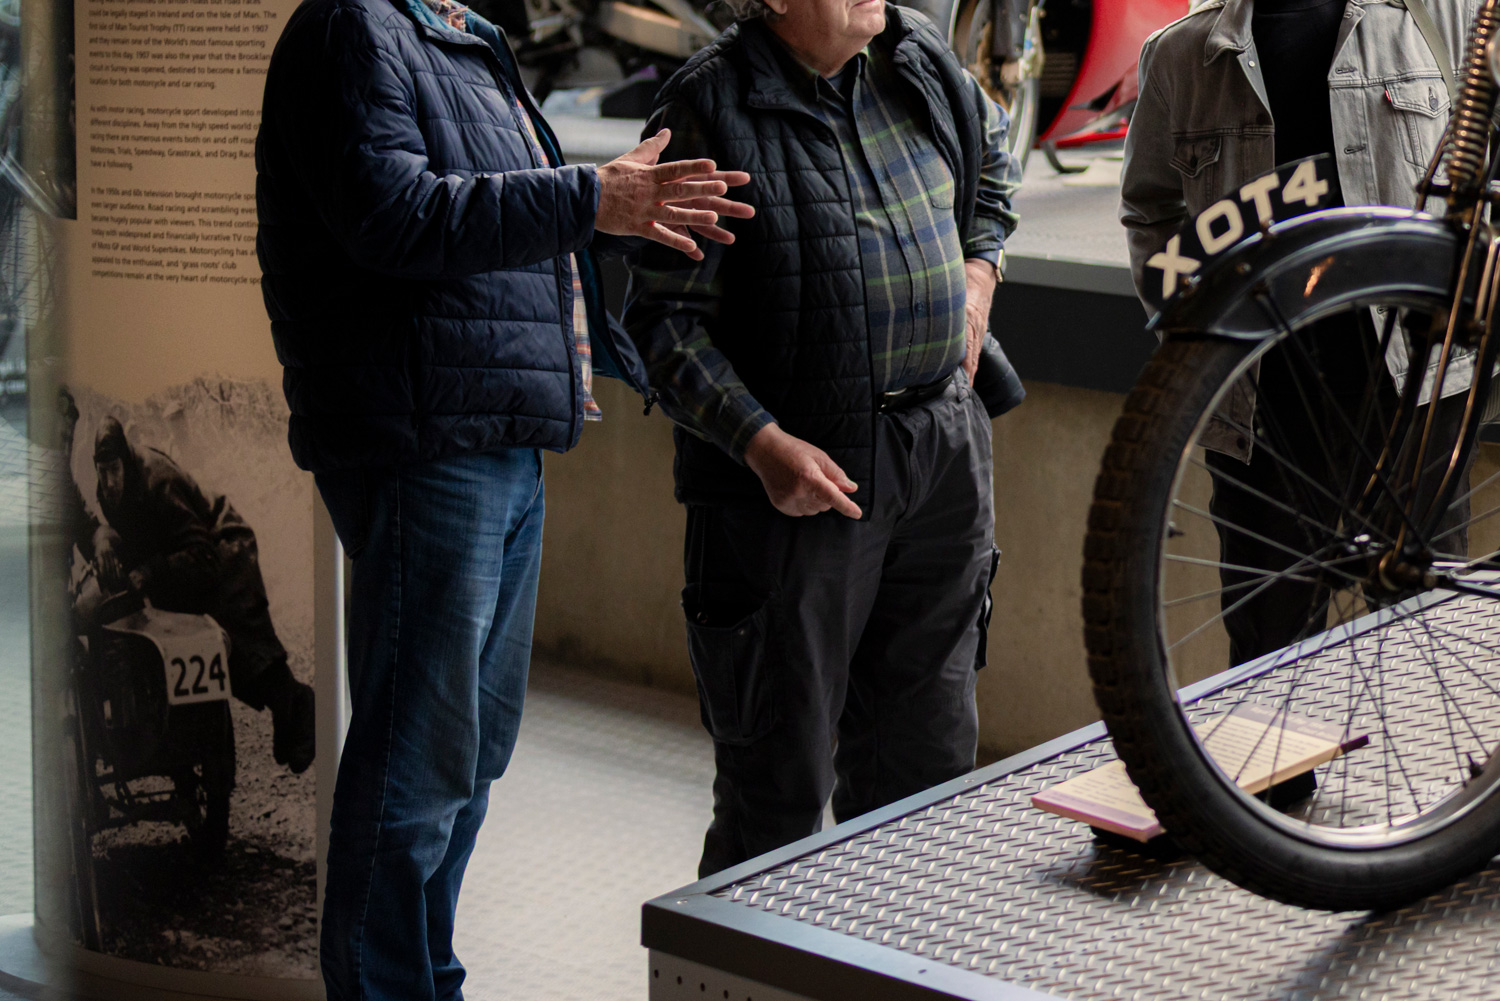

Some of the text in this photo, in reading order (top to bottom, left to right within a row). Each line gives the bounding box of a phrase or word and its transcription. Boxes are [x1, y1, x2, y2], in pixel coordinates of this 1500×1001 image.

[129, 10, 150, 19] staged
[157, 10, 180, 18] Ireland
[181, 10, 196, 18] and
[243, 11, 260, 19] Man.
[129, 23, 149, 32] Tourist
[150, 23, 171, 33] Trophy
[225, 24, 241, 33] held
[252, 24, 268, 33] 1907
[208, 38, 234, 47] famous
[235, 39, 266, 49] sporting
[136, 51, 150, 59] 1907
[208, 52, 223, 60] that
[168, 66, 196, 74] destined
[207, 66, 235, 75] become
[118, 78, 132, 86] both
[133, 79, 166, 89] motorcycle
[167, 80, 181, 88] and
[147, 107, 182, 117] motorcycle
[183, 108, 200, 117] sport
[201, 108, 239, 117] developed
[240, 109, 254, 117] into
[143, 121, 160, 130] Away
[161, 121, 177, 129] from
[191, 121, 207, 131] high
[208, 122, 229, 131] speed
[230, 122, 252, 130] world
[130, 135, 162, 143] numerous
[184, 135, 201, 143] both
[213, 136, 227, 144] and
[220, 149, 237, 160] Drag
[144, 190, 174, 198] television
[174, 190, 202, 201] brought
[203, 192, 242, 201] motorcycle
[148, 203, 164, 212] Road
[165, 205, 186, 215] racing
[201, 205, 239, 216] scrambling
[129, 217, 153, 225] popular
[154, 217, 169, 226] with
[198, 218, 212, 227] This
[213, 220, 233, 228] trend
[118, 230, 151, 239] widespread
[166, 231, 200, 242] financially
[201, 233, 231, 242] lucrative
[132, 244, 150, 253] World
[189, 246, 235, 257] Motorcycling
[222, 261, 237, 270] club
[165, 275, 180, 283] very
[180, 274, 199, 282] heart
[209, 276, 248, 285] motorcycle
[170, 651, 227, 697] 224
